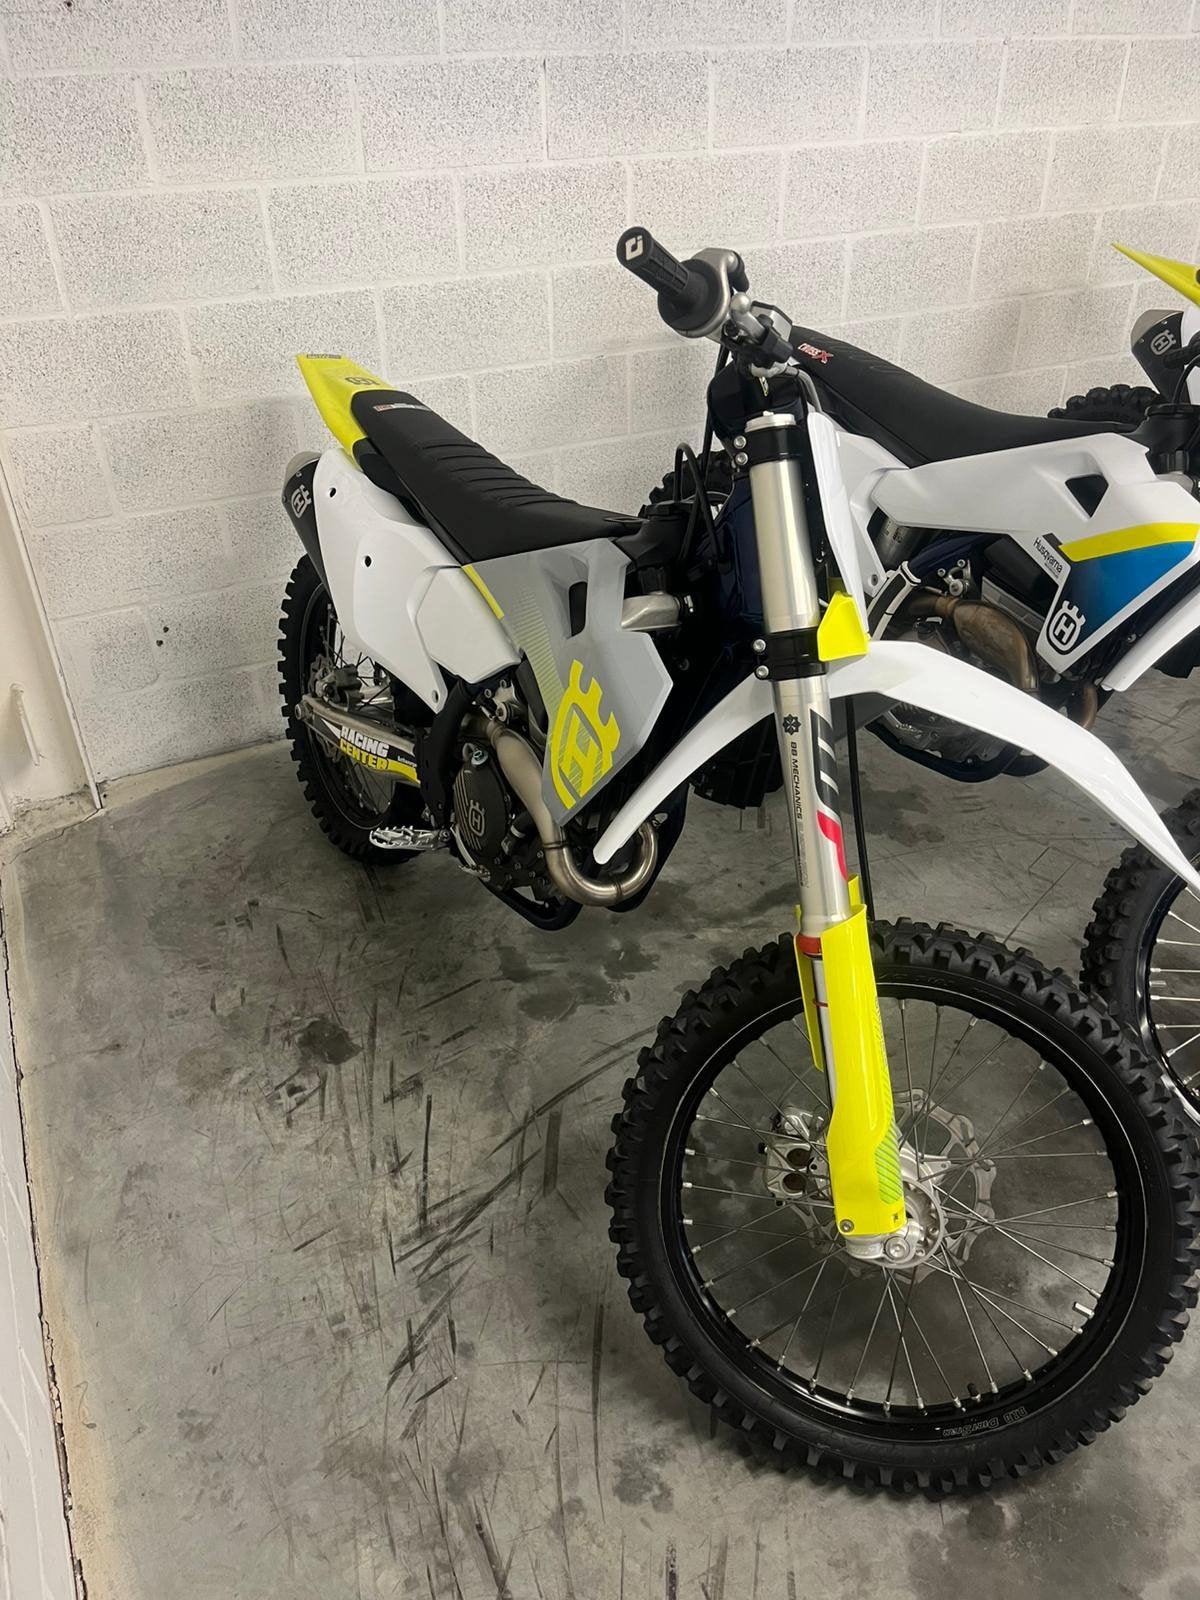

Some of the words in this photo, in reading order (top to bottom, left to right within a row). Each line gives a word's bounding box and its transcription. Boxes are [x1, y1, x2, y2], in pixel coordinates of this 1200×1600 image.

[1033, 537, 1064, 573] Husqvarna
[339, 737, 388, 770] CENTER
[340, 725, 390, 758] RACING
[792, 758, 803, 820] MECHANICS
